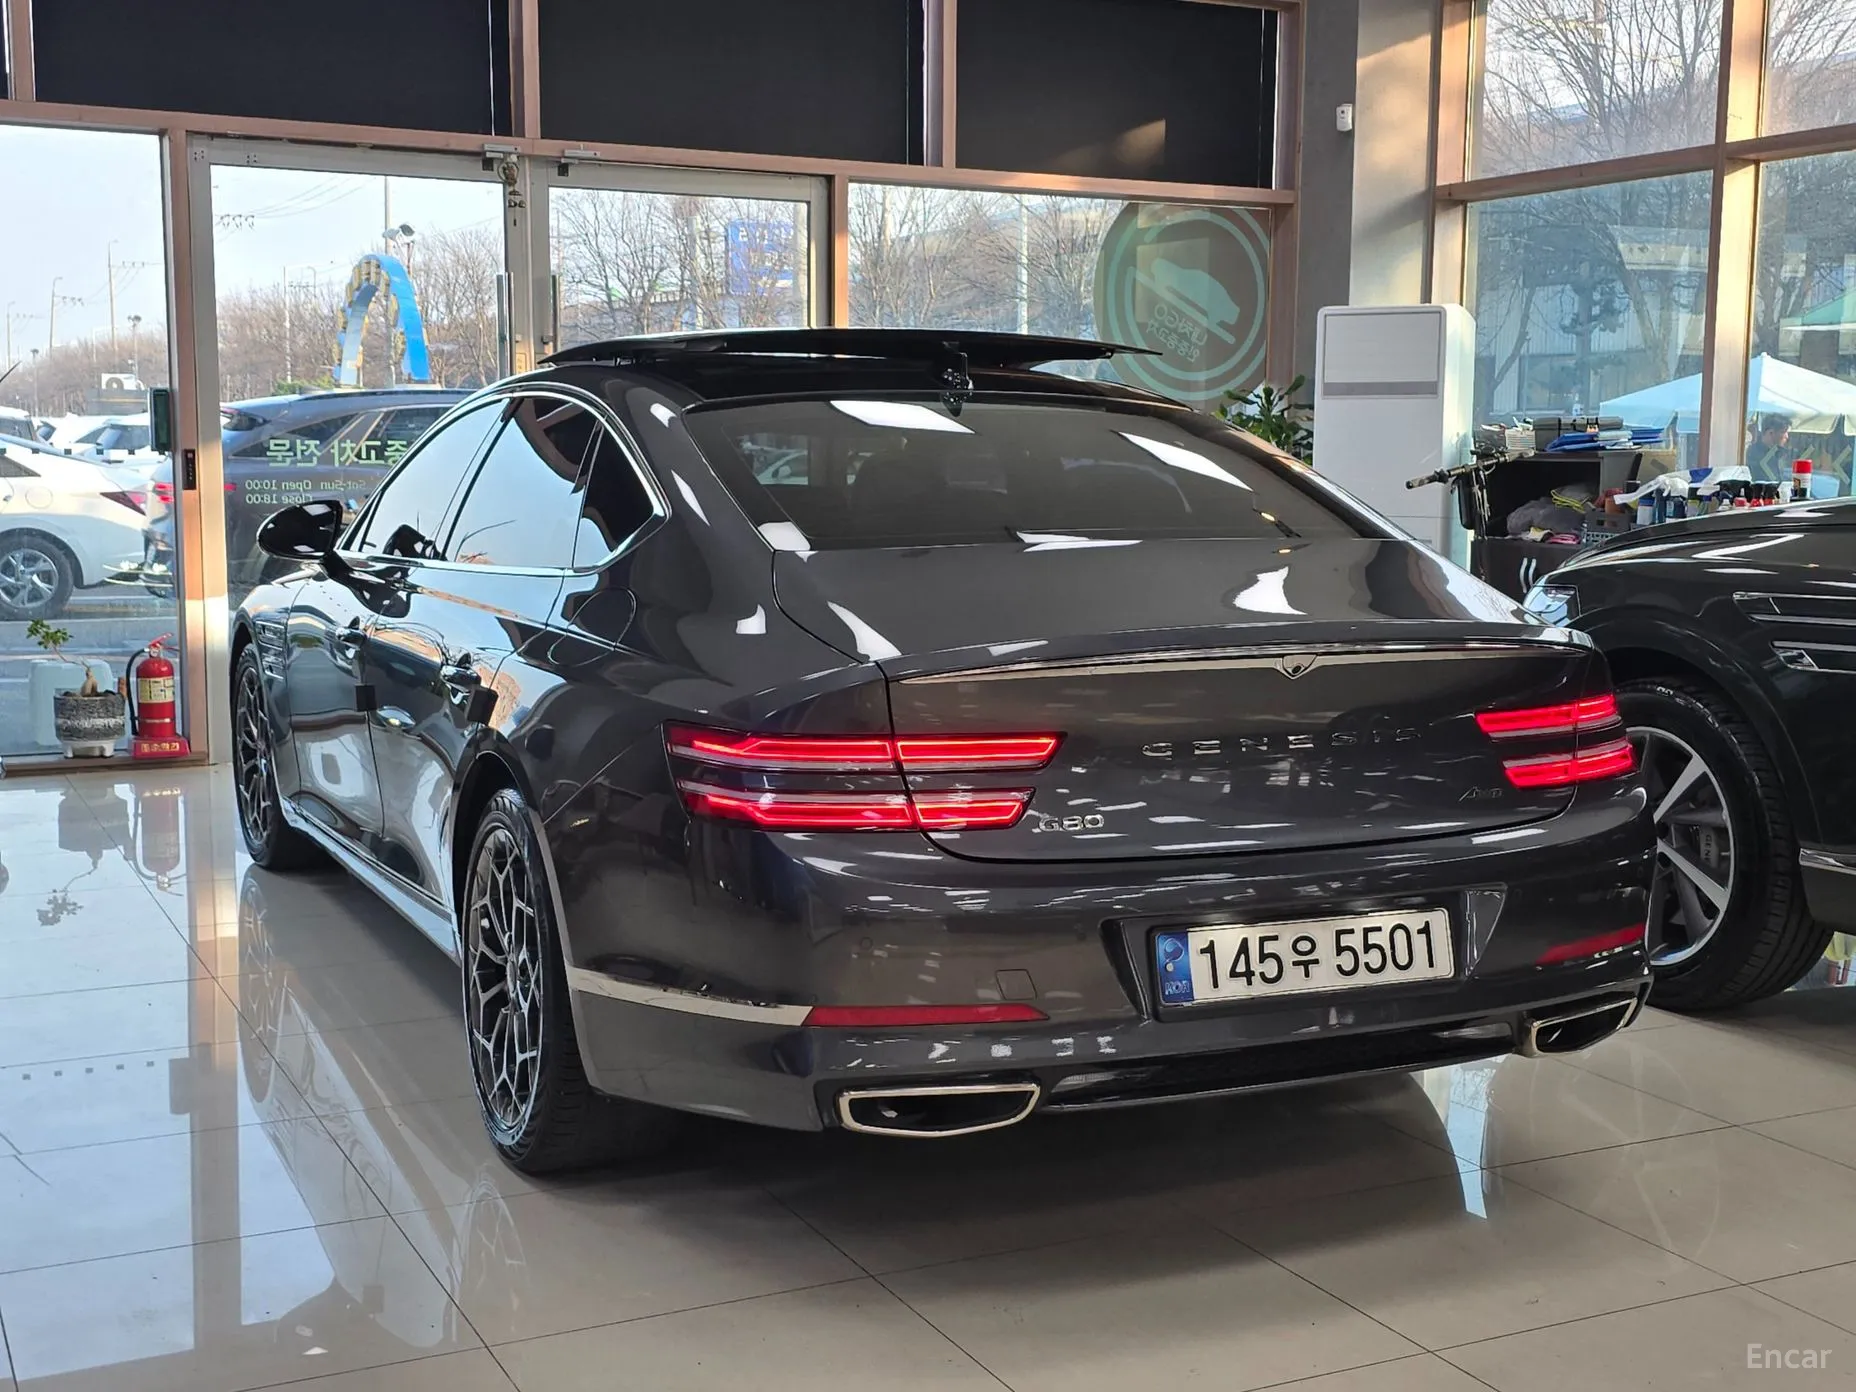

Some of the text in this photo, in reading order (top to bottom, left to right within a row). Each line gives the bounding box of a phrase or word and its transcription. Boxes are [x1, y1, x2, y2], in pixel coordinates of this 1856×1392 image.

[1142, 727, 1421, 758] GENESIS
[1038, 814, 1104, 832] G80
[1199, 920, 1435, 989] 145우 5501
[1165, 978, 1190, 995] KOR
